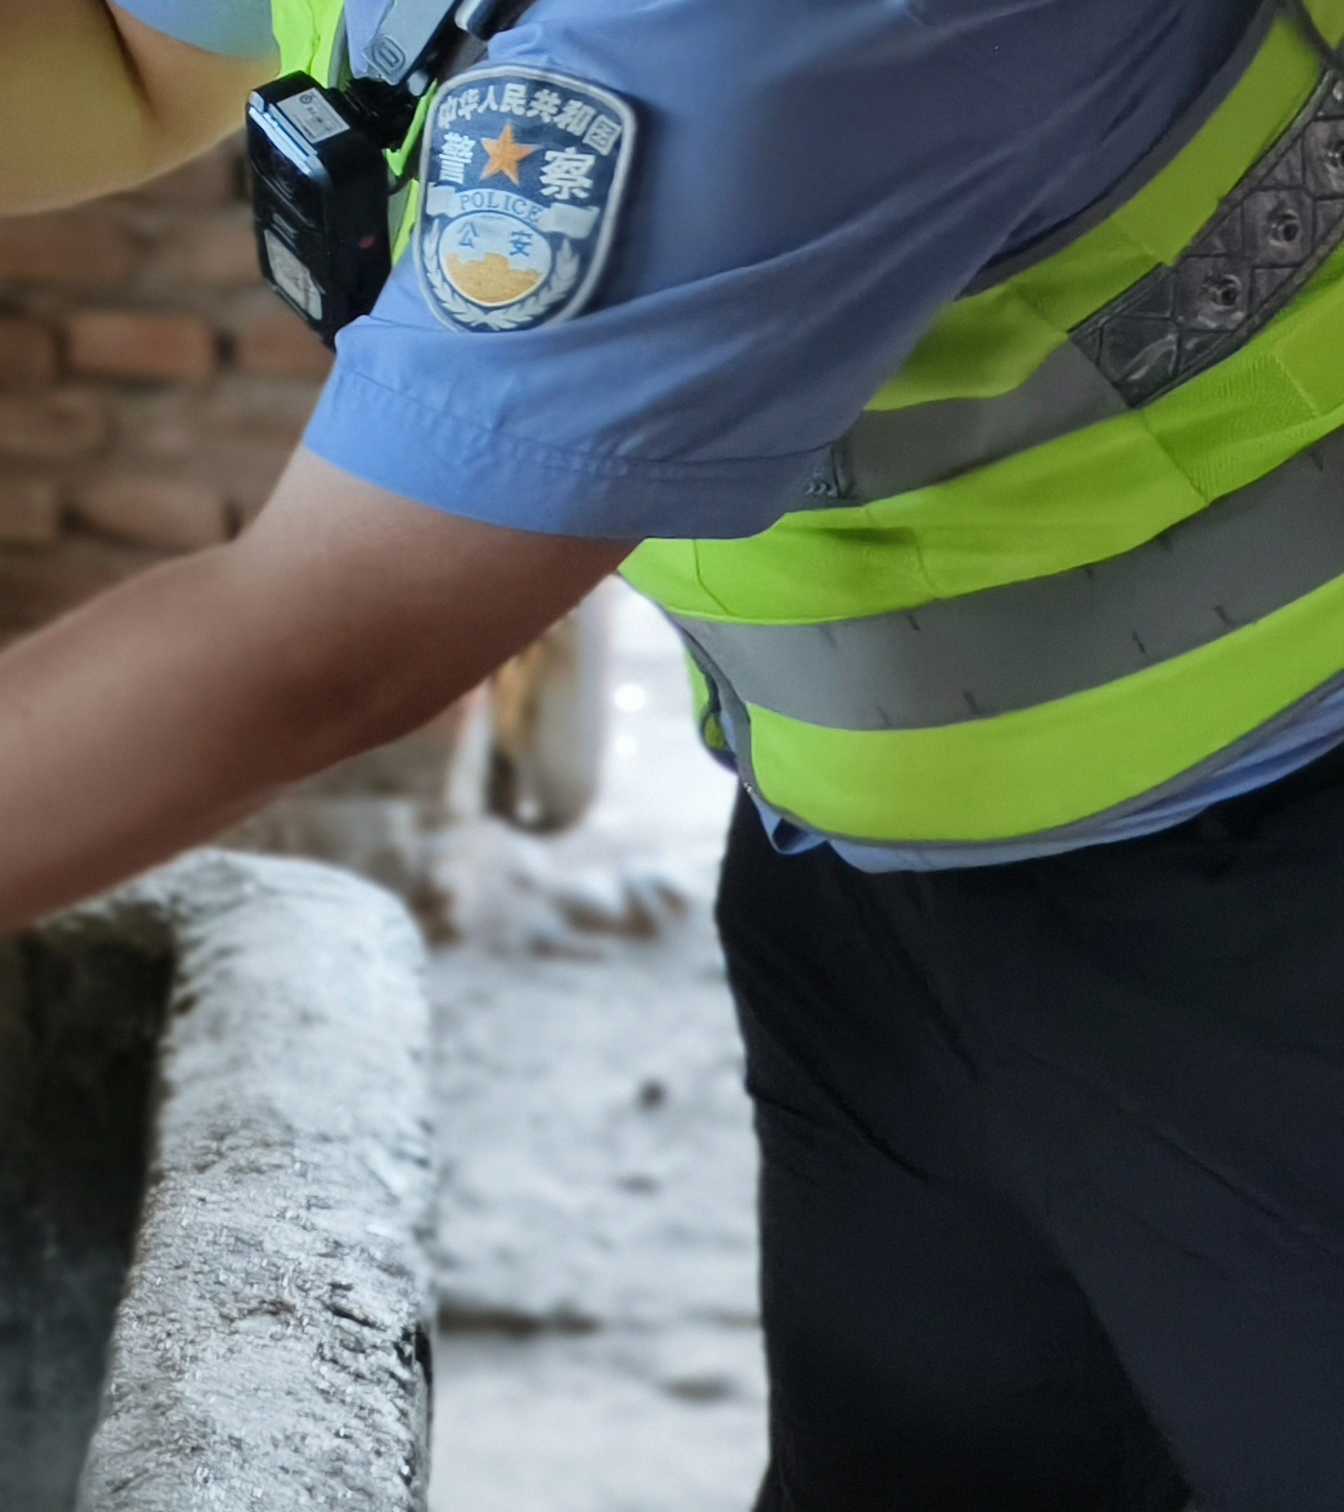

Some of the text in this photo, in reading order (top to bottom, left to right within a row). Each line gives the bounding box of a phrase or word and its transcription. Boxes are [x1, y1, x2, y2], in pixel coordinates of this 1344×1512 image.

[438, 82, 622, 156] 中华人民共和国
[439, 131, 596, 200] 警 察
[458, 190, 546, 224] POLICE
[457, 221, 533, 257] 公 安
